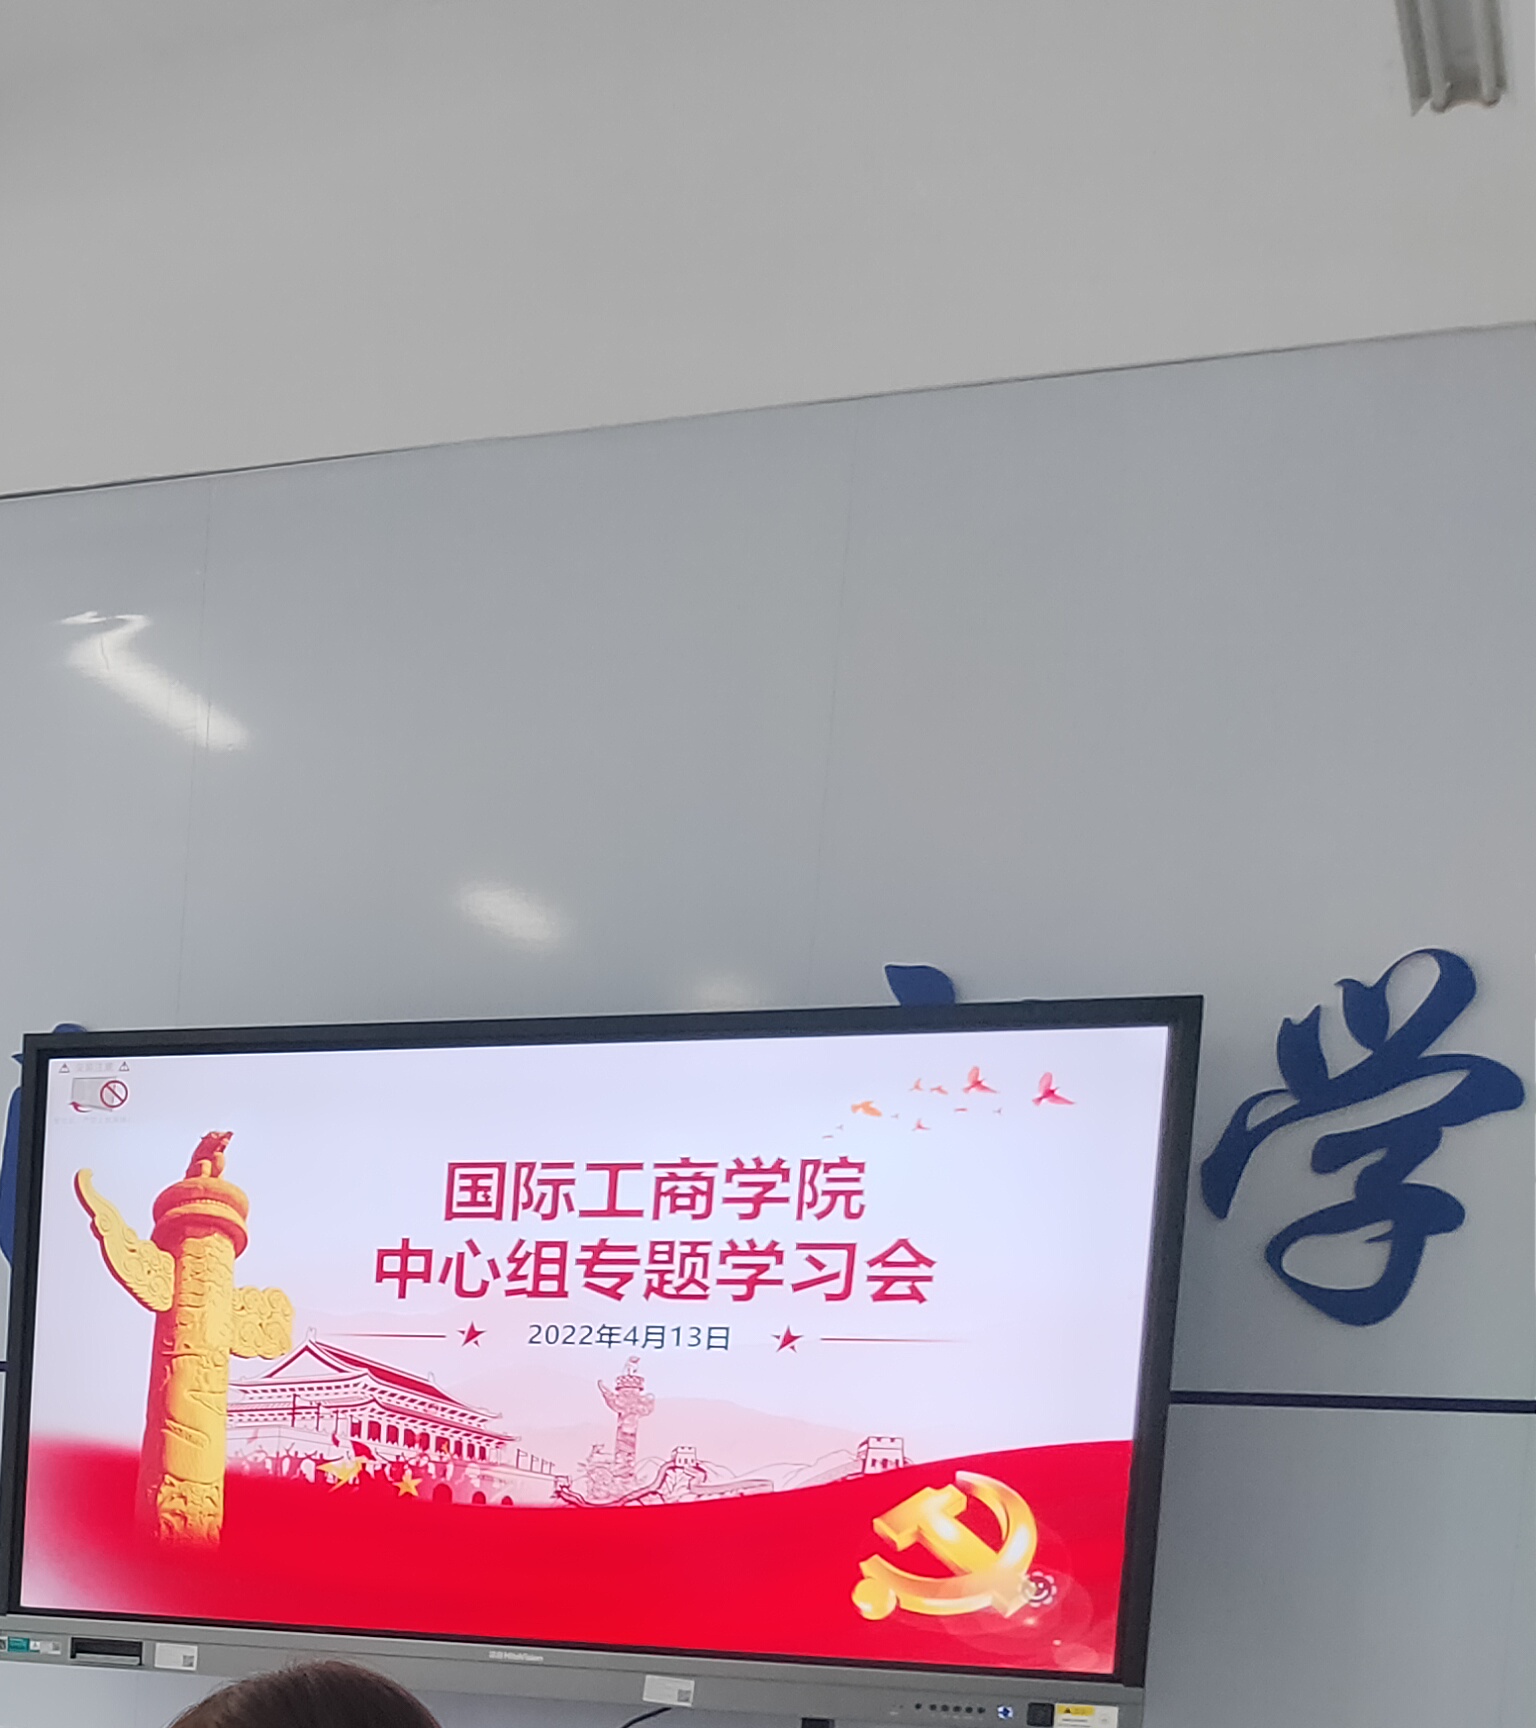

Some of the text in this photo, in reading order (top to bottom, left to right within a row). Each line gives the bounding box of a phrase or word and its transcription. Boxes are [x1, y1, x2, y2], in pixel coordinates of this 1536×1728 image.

[1200, 947, 1526, 1327] 学
[442, 1155, 867, 1222] 国际工商学院
[374, 1237, 937, 1305] 中心组专题学习会
[527, 1323, 732, 1352] 2022年4月13日
